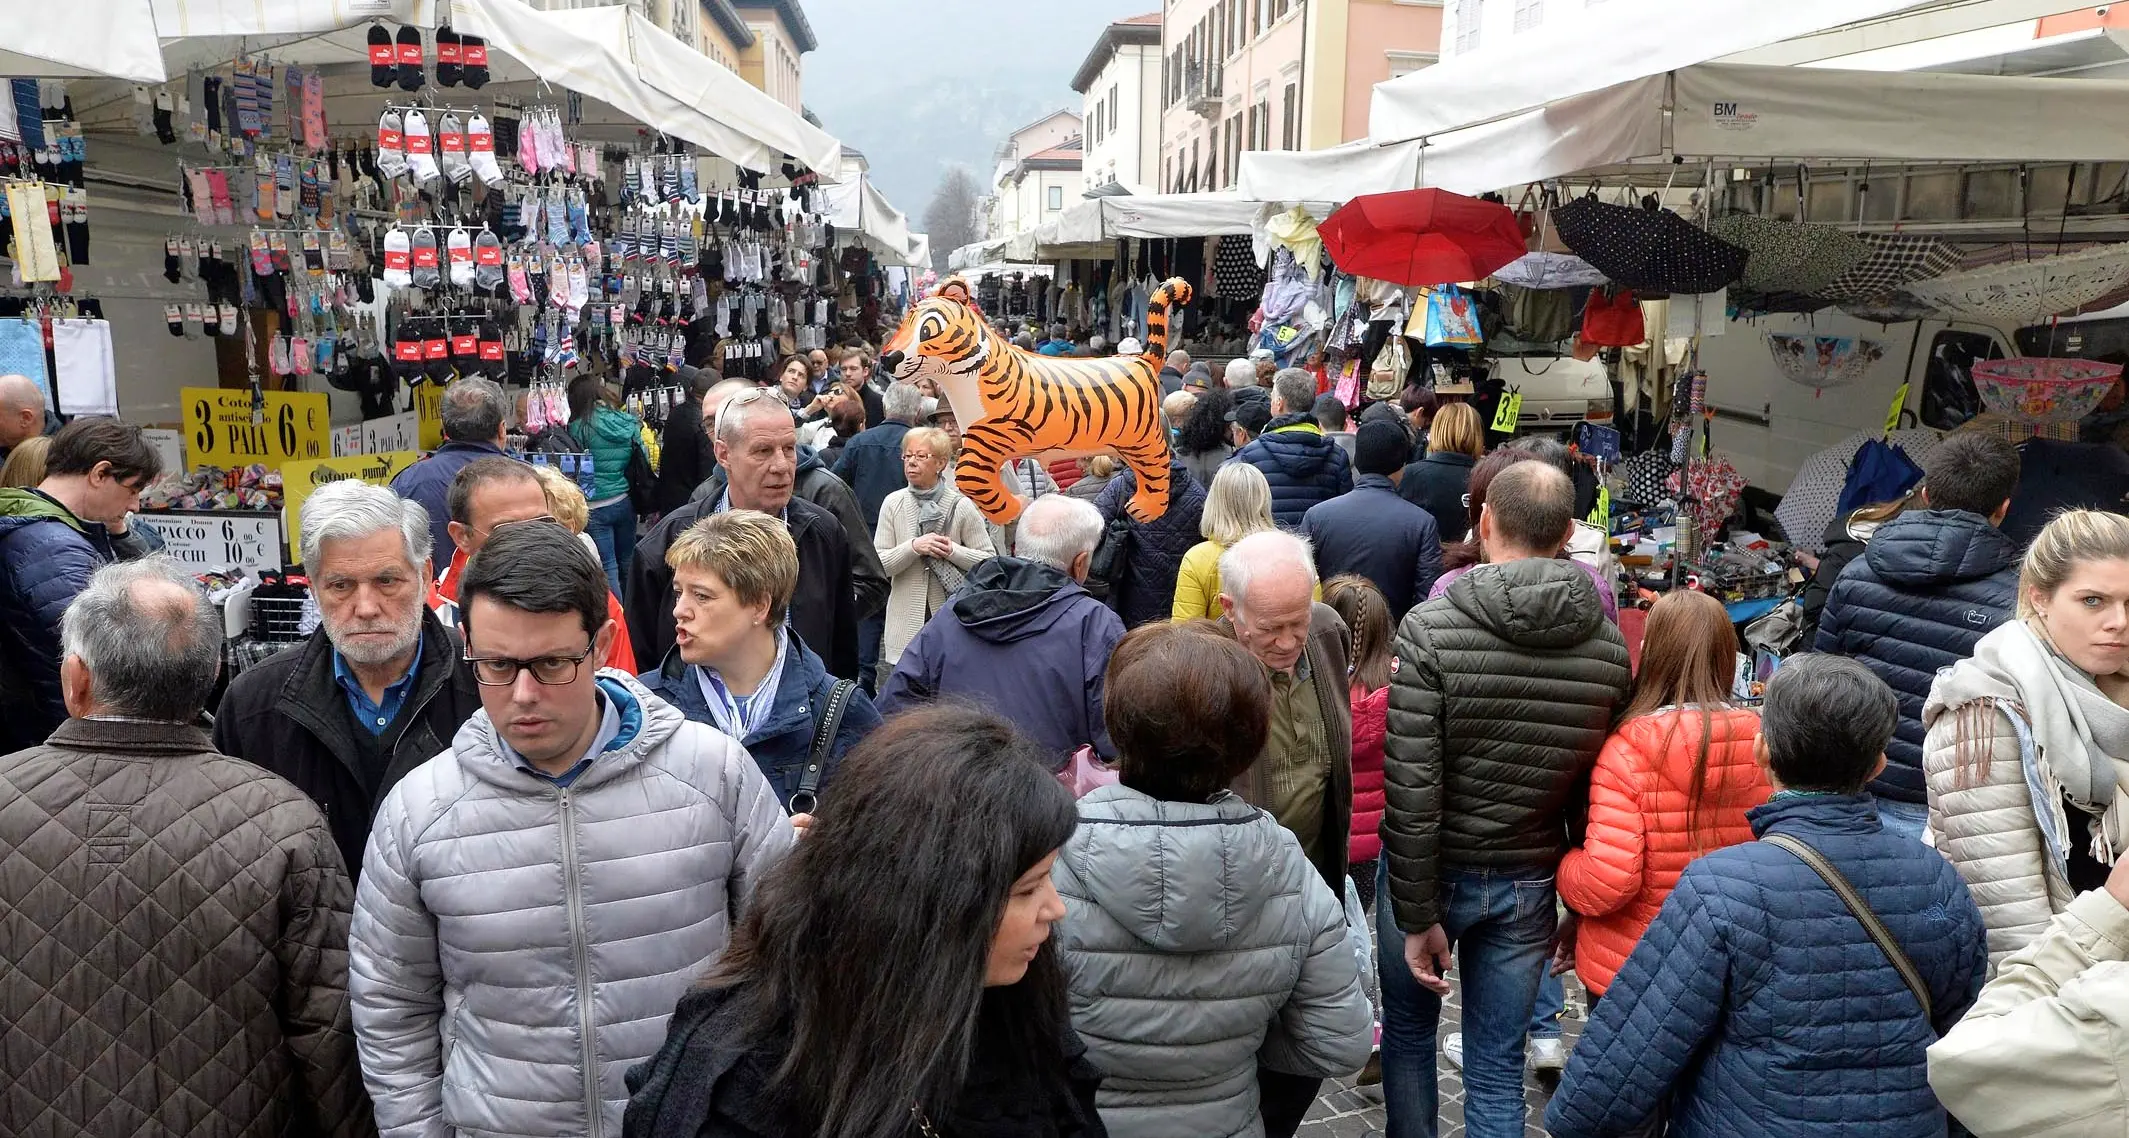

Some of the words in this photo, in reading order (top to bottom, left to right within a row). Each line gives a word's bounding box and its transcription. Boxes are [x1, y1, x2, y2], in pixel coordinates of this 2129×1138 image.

[1714, 103, 1737, 116] BM
[218, 396, 269, 408] Cotoe
[195, 399, 214, 453] 3
[228, 424, 268, 456] PAIA
[362, 466, 387, 479] PUMA
[157, 525, 206, 540] PACCO
